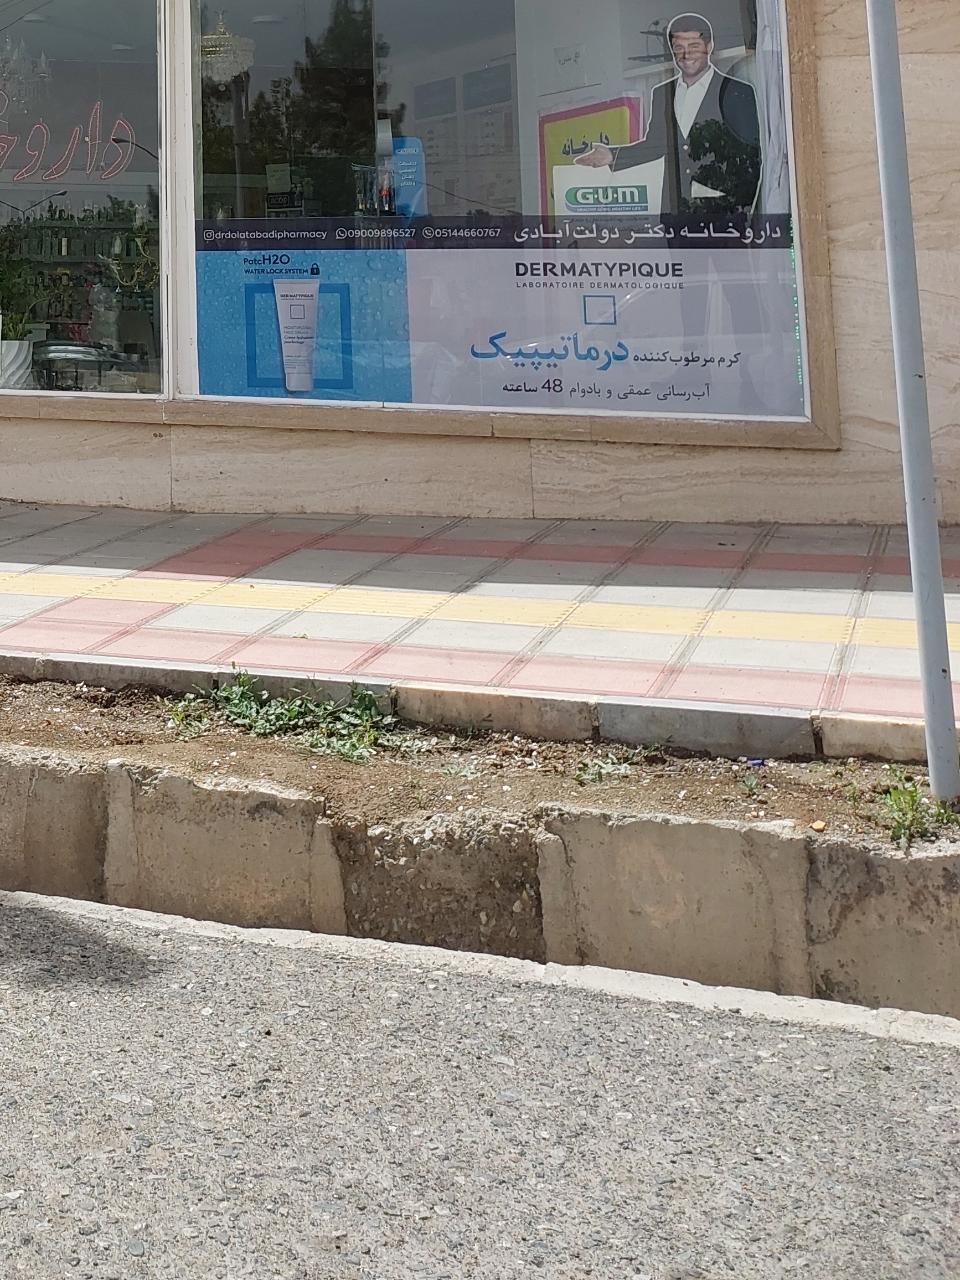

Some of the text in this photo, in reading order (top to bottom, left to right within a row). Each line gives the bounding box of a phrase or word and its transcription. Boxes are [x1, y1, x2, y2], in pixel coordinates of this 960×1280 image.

[215, 228, 501, 240] drdolatabadipharmacy 09009896527 05144660767
[624, 223, 675, 244] دکتر
[680, 222, 781, 244] داروخانه
[243, 254, 290, 265] PatcH2O
[515, 262, 683, 277] DERMATYPIQUE
[516, 281, 585, 289] LABORATOIRE
[470, 331, 629, 370] درماتیپیک
[717, 352, 741, 367] کرم
[502, 381, 538, 393] ساعته
[541, 378, 563, 393] 48
[569, 382, 600, 398] بادوام
[617, 384, 651, 399] عمقی
[606, 389, 612, 398] و
